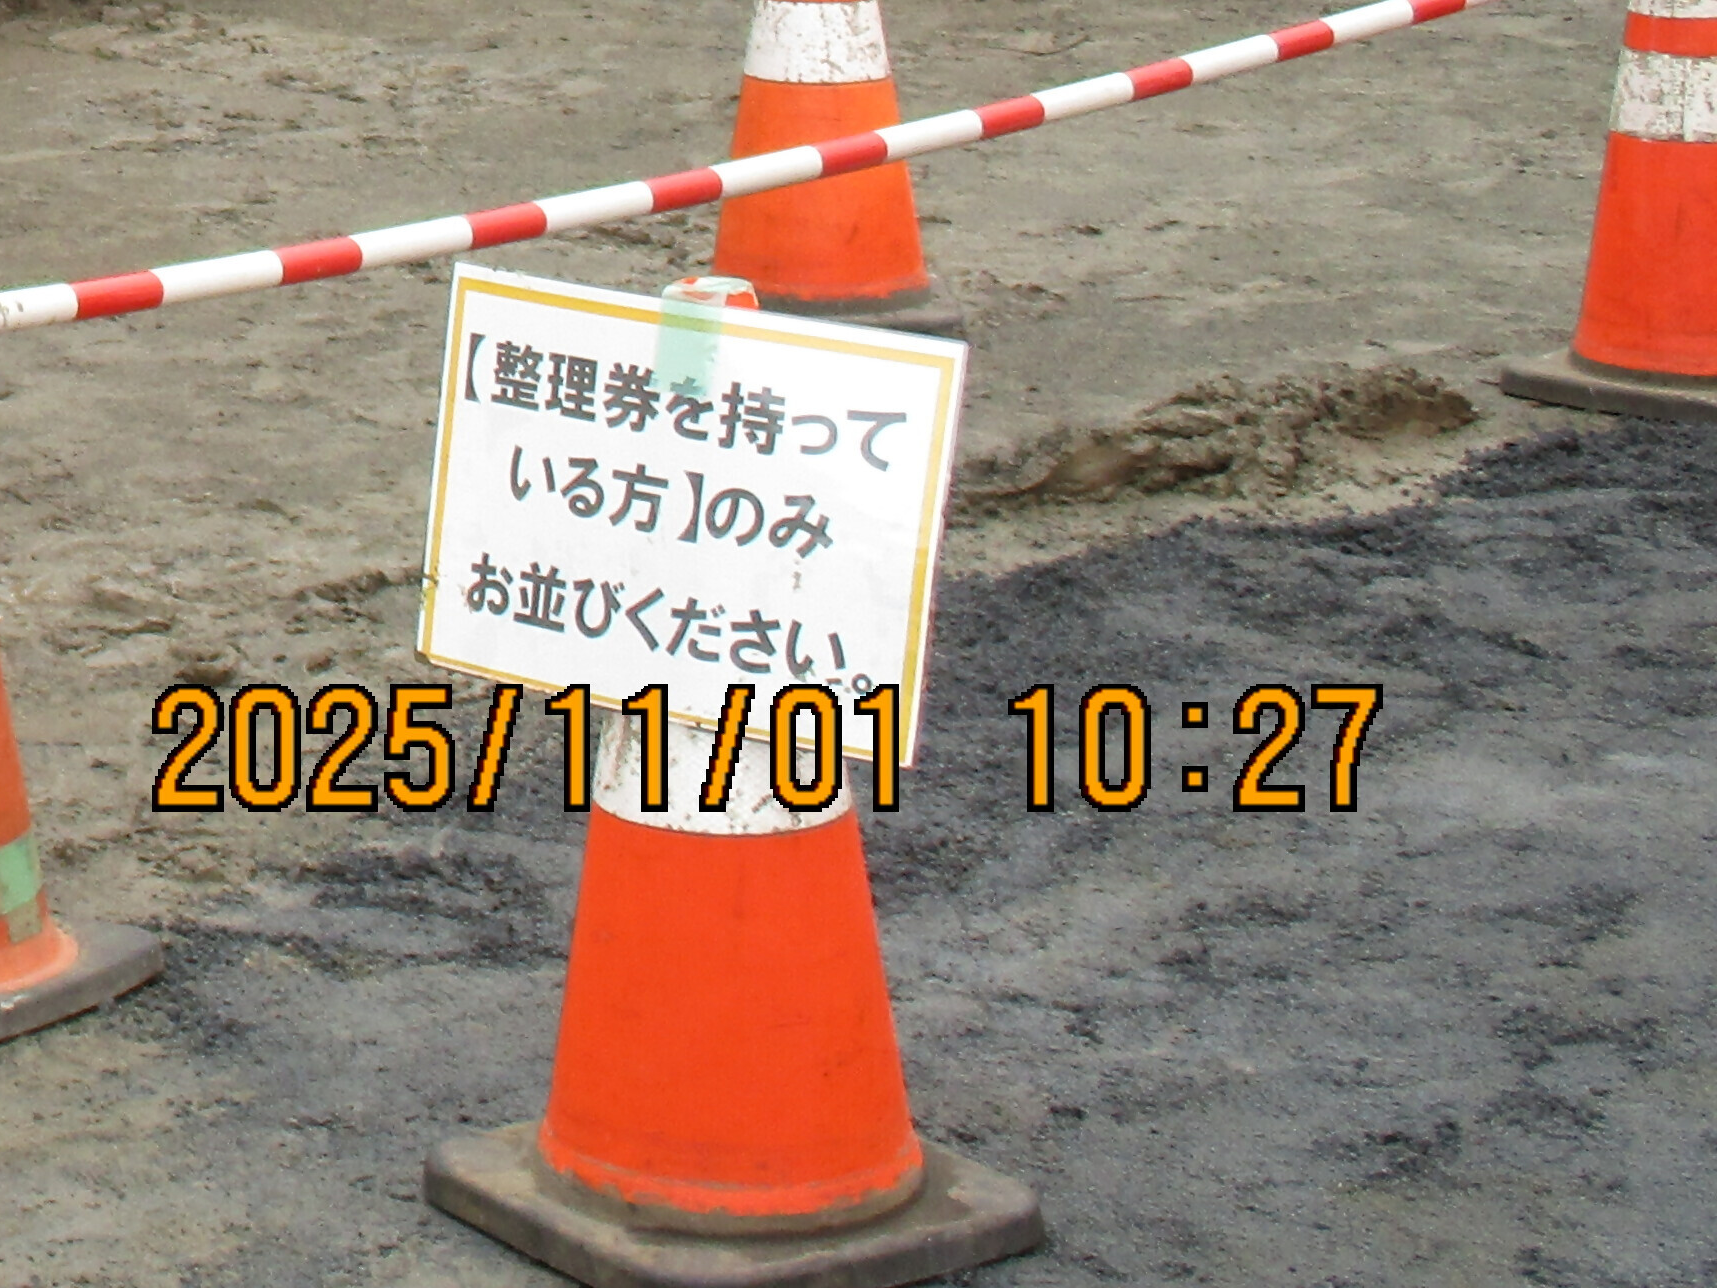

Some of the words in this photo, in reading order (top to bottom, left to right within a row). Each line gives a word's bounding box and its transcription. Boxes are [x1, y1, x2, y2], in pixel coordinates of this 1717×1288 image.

[464, 332, 907, 472] 【整理券を持って
[509, 444, 834, 558] いる方】のみ
[464, 552, 873, 696] お並びください。
